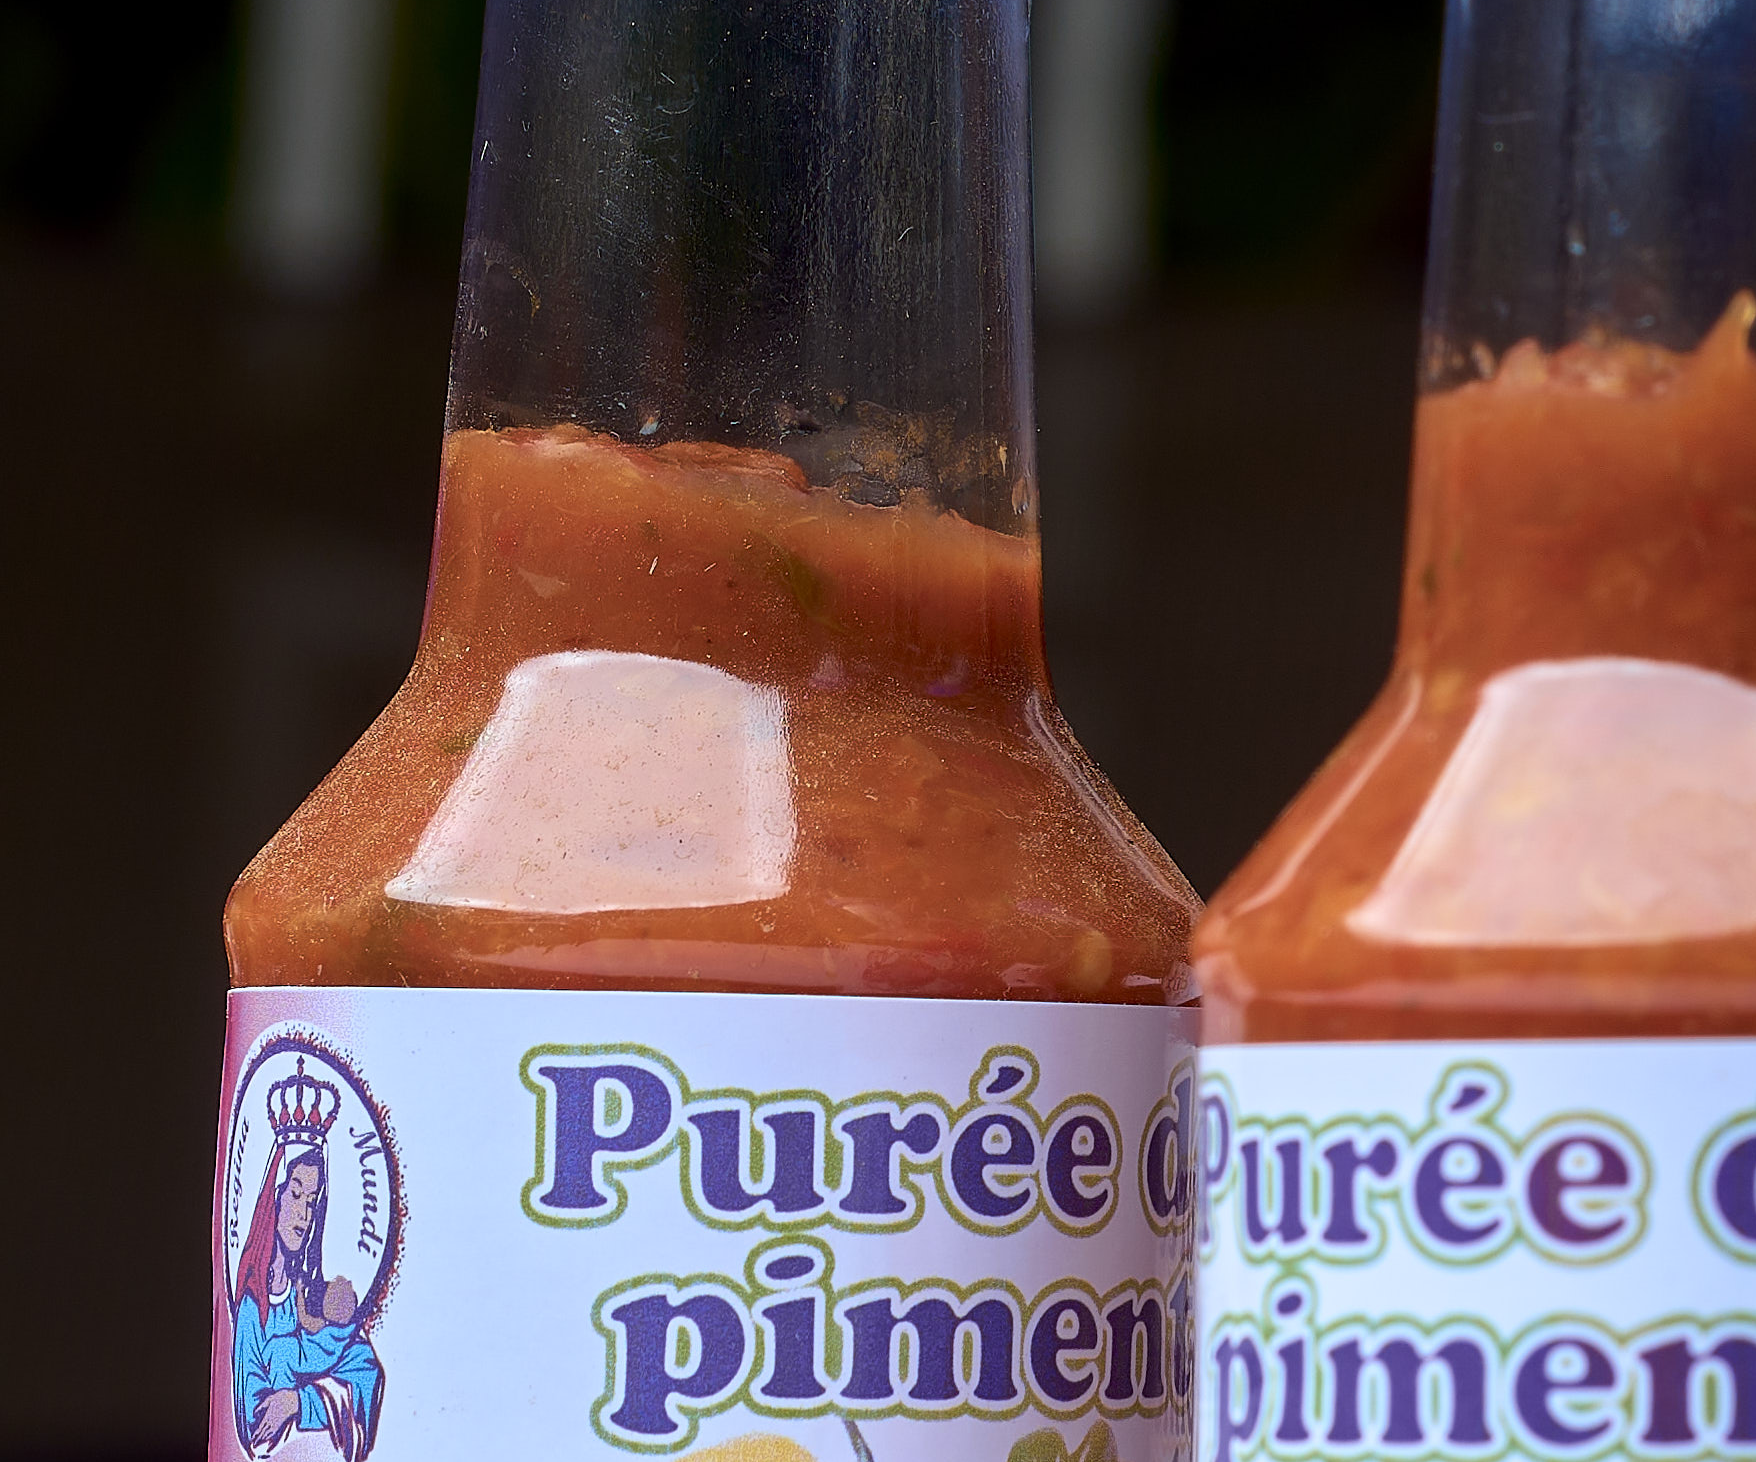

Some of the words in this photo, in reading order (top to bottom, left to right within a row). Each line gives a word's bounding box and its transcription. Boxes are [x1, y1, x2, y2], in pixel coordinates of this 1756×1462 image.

[229, 1115, 250, 1250] Regina
[349, 1126, 384, 1259] Mundi
[529, 1054, 1117, 1229] Purée
